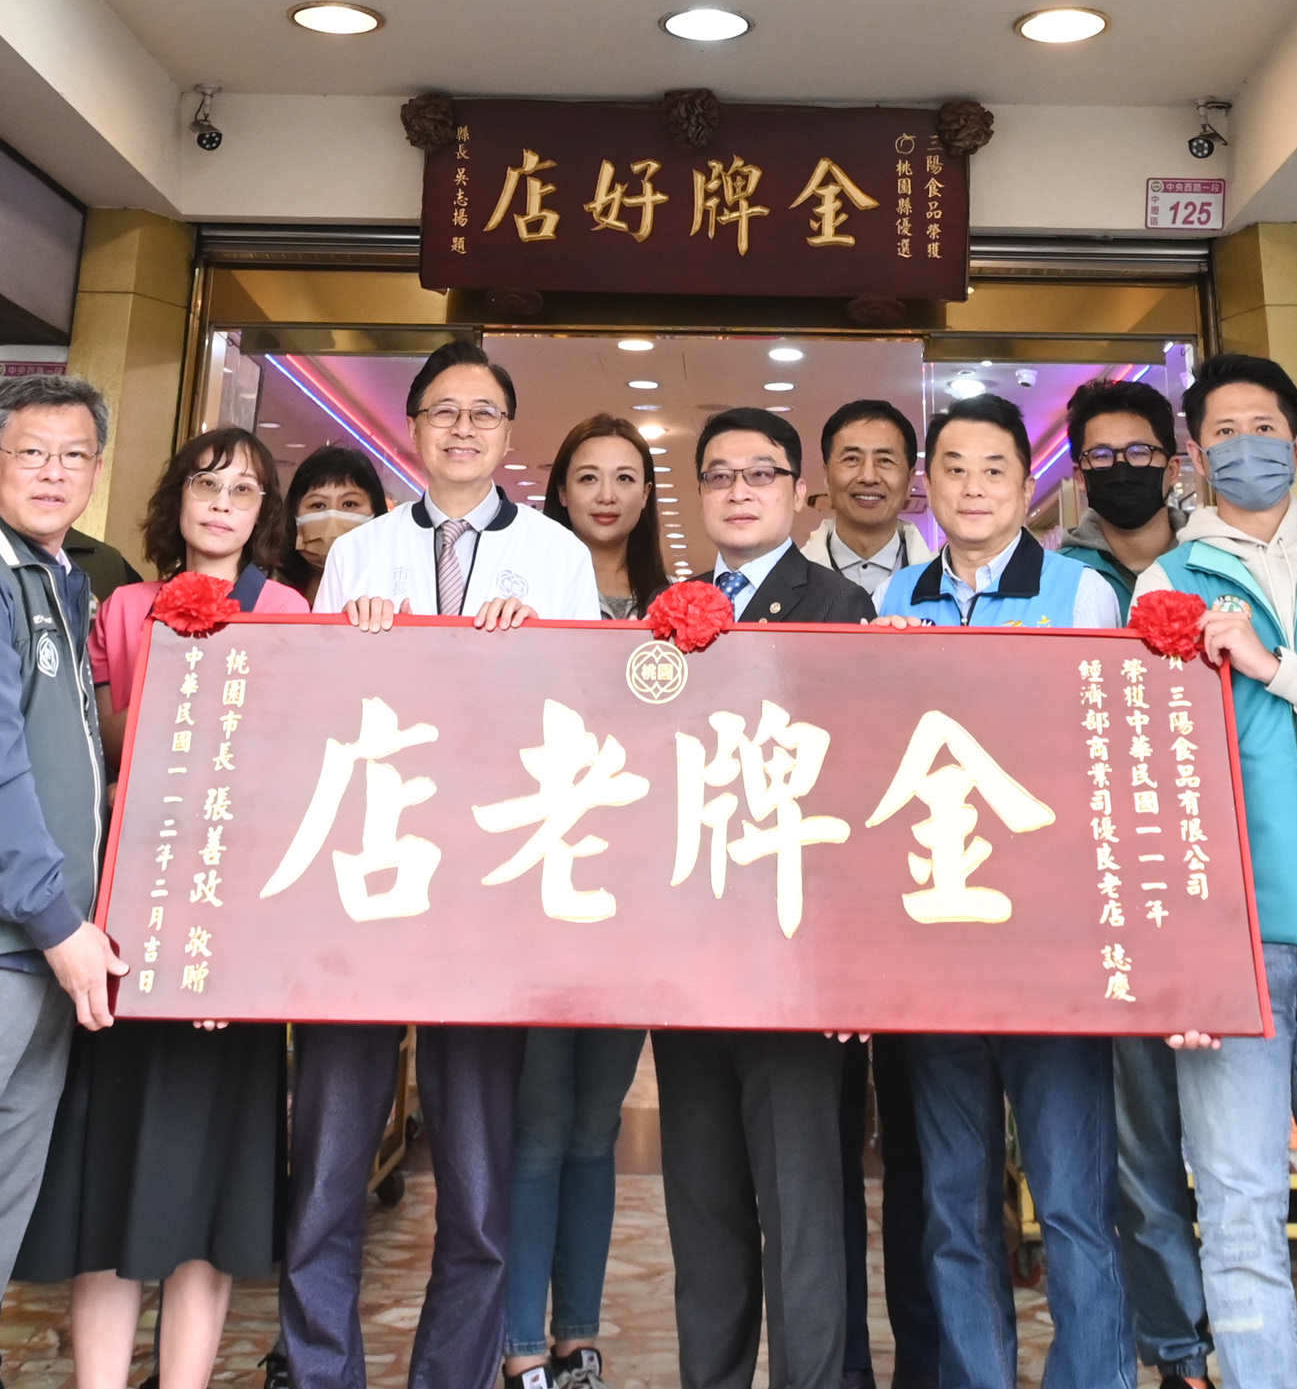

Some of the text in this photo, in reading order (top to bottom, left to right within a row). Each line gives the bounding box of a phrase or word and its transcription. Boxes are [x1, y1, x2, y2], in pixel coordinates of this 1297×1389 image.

[924, 134, 946, 259] 三陽食品榮獲
[1166, 182, 1221, 193] 中央西路一段
[1169, 200, 1213, 226] 125
[138, 645, 204, 994] 中華民國一一二年二月吉日
[259, 695, 1057, 940] 金牌老店
[1120, 658, 1170, 929] 榮獲中華民國一一一年
[1168, 686, 1211, 901] 三陽食品有限公司
